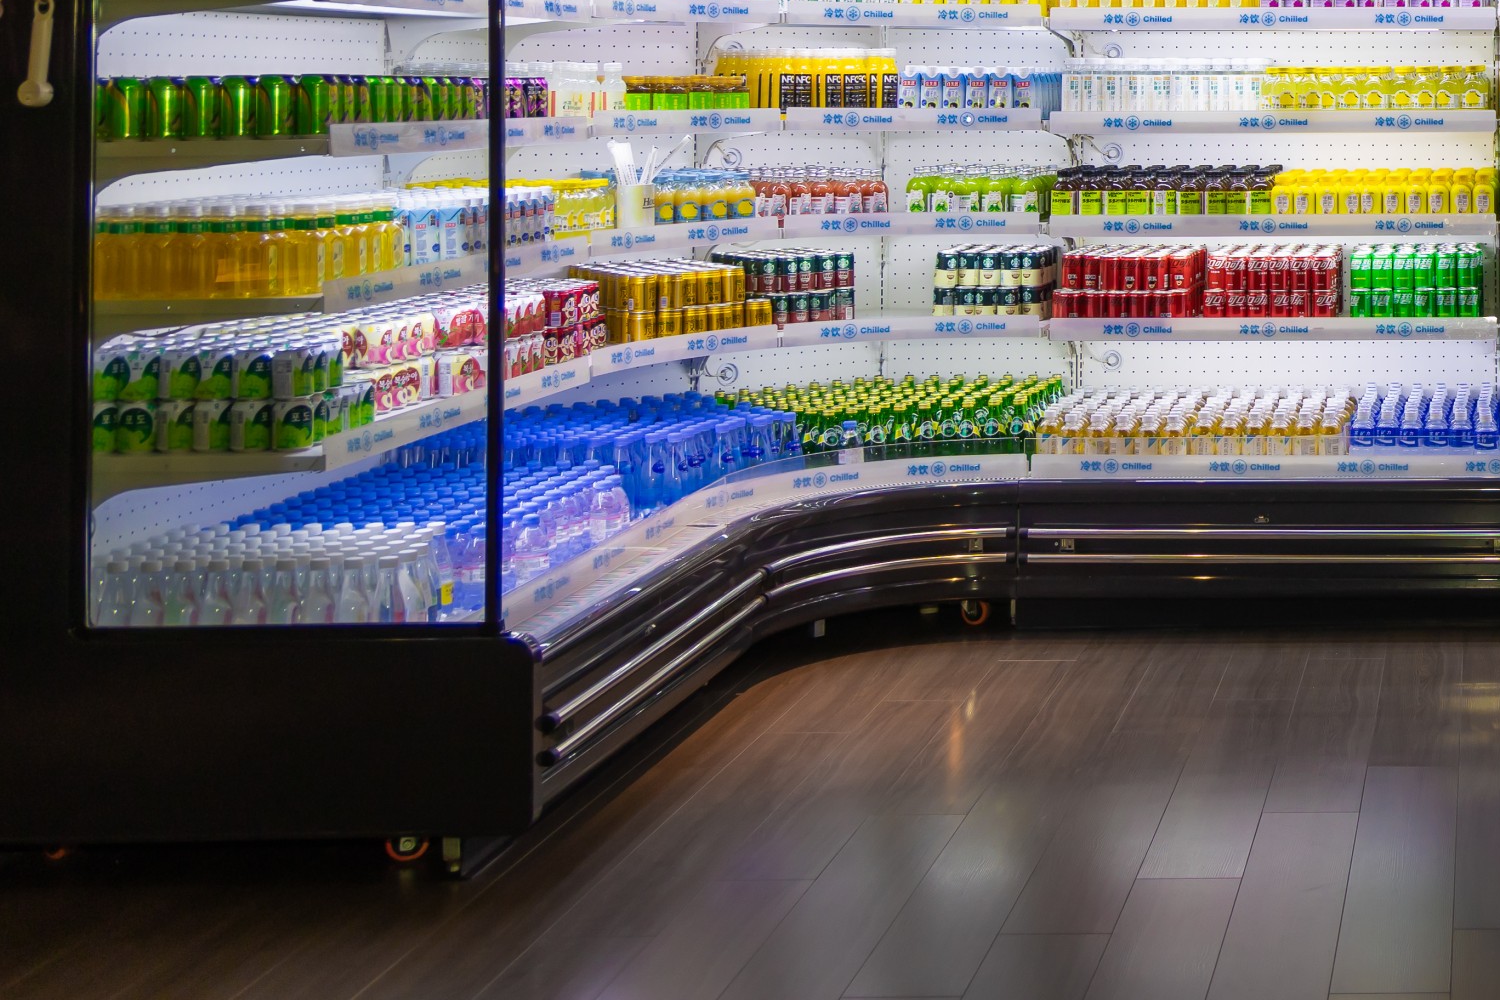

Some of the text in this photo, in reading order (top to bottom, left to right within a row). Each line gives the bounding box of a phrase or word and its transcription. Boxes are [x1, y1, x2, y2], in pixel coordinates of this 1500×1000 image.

[824, 8, 894, 19] 冷饮 Chilled
[938, 9, 1008, 20] 冷饮 Chilled
[1239, 13, 1259, 24] 冷饮
[1103, 14, 1123, 24] 冷饮
[796, 75, 812, 84] NFC
[823, 114, 843, 124] 冷饮
[937, 114, 1008, 124] 冷饮 Chilled
[1103, 118, 1123, 128] 冷饮
[1375, 117, 1395, 126] 冷饮
[935, 218, 1006, 228] 冷饮 Chilled
[1103, 221, 1172, 231] 冷饮 Chilled
[820, 326, 892, 338] 冷饮 Chilled
[935, 322, 955, 332] 冷饮
[1103, 325, 1172, 334] 冷饮 Chilled
[908, 464, 980, 475] 冷饮 Chilled
[1080, 461, 1101, 471] 冷饮
[1338, 462, 1358, 472] 冷饮
